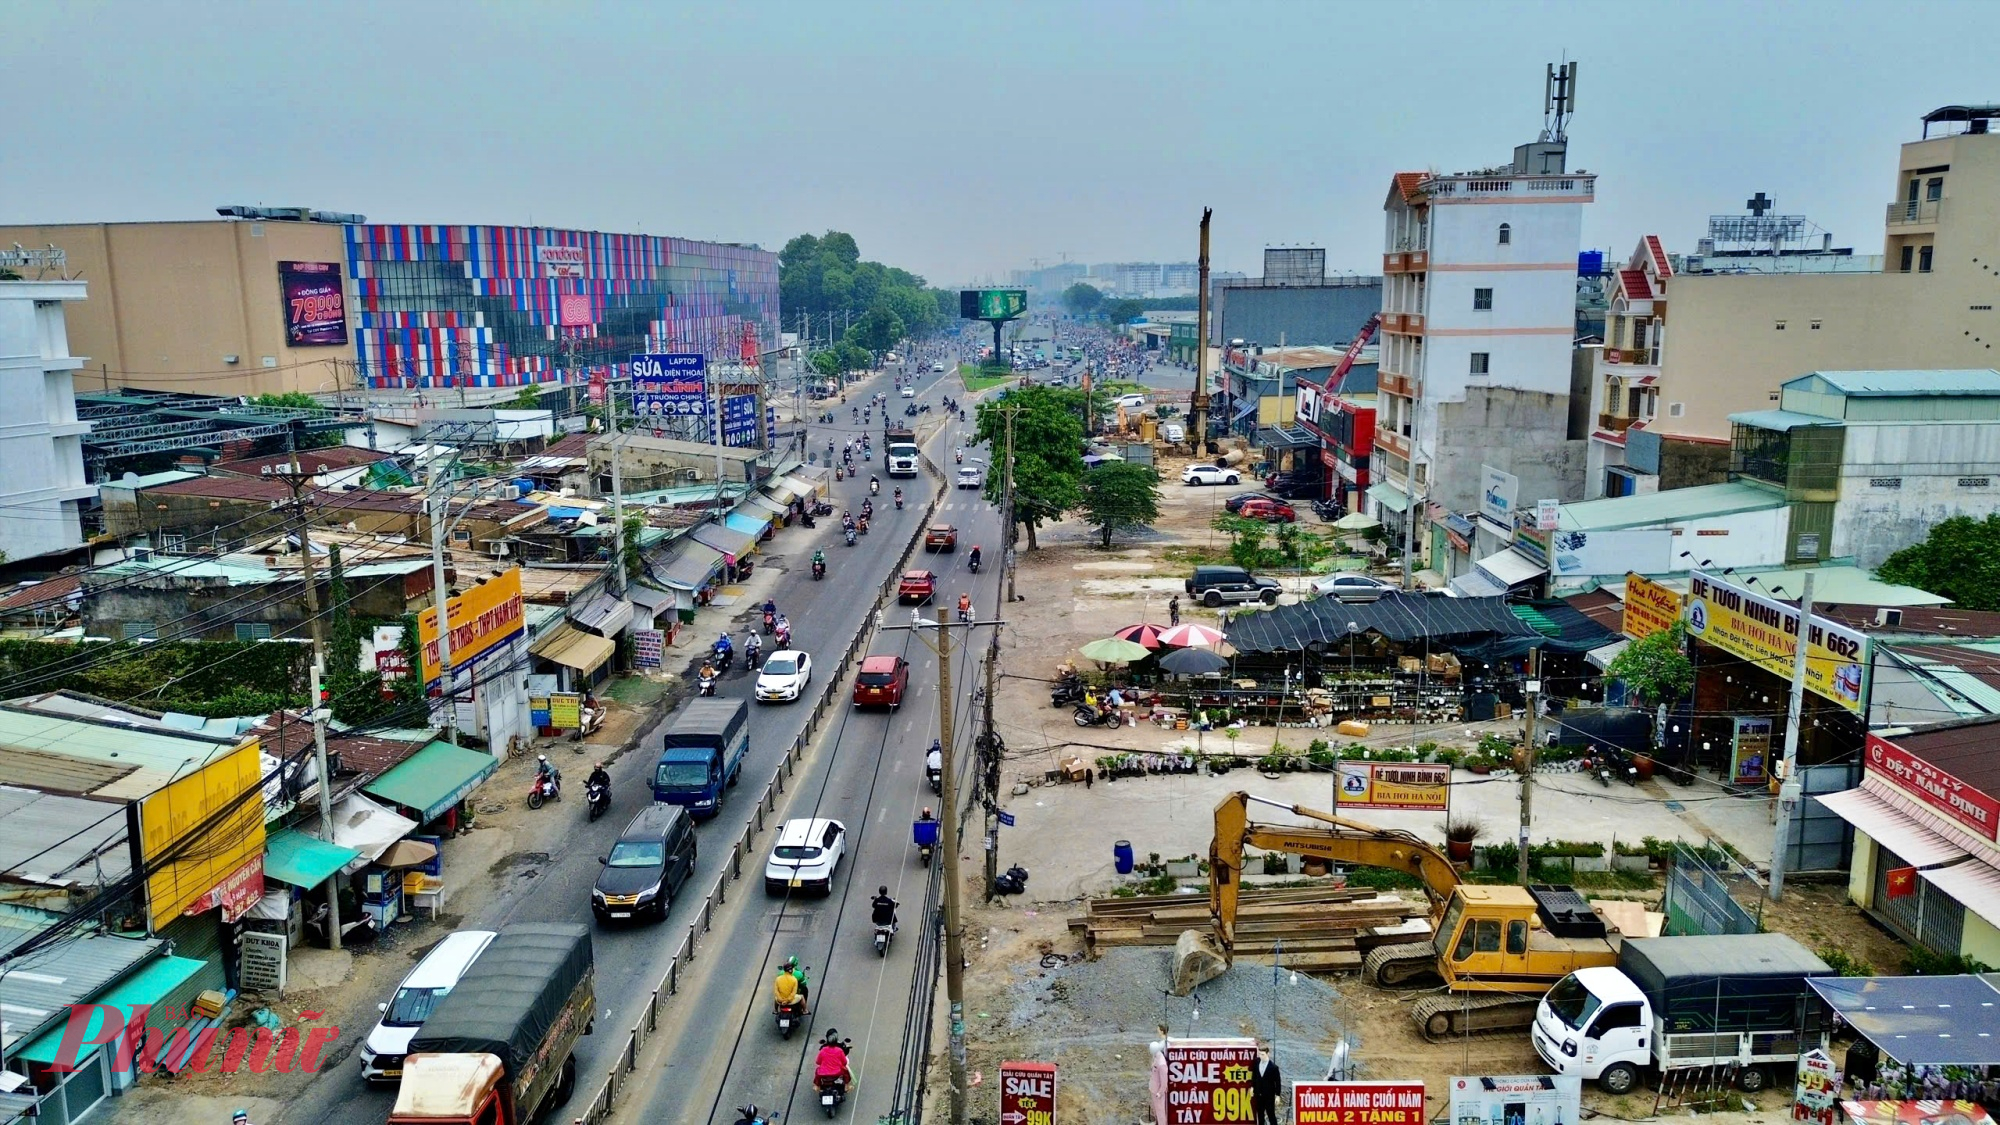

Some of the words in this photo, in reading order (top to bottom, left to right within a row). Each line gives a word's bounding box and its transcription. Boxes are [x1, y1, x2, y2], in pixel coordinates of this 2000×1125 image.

[632, 356, 663, 377] SỬA
[664, 368, 680, 378] ĐIỆN
[682, 370, 704, 378] THOẠI
[662, 378, 703, 393] KÍNH
[1692, 578, 1708, 600] DÊ
[1712, 586, 1740, 612] TƯƠI
[1744, 599, 1780, 629] NINH
[1826, 632, 1860, 661] 662
[1730, 617, 1746, 632] BIA
[1768, 632, 1782, 649] HÀ
[1756, 644, 1769, 656] Liên
[1376, 769, 1384, 780] DÊ
[1434, 772, 1446, 782] 662
[1911, 760, 1936, 779] ĐẠI
[1942, 776, 1962, 792] LÝ
[1377, 792, 1391, 800] BIA
[1412, 791, 1424, 800] HÀ
[1886, 757, 1912, 780] DỆT
[1916, 773, 1946, 800] NAM
[1950, 792, 1988, 822] ĐỊNH
[1284, 841, 1332, 852] MITSUBISHI
[1168, 1048, 1187, 1060] GIẢI
[1190, 1050, 1208, 1060] CỨU
[1210, 1048, 1236, 1062] QUẦN
[1238, 1049, 1255, 1060] TÂY
[1168, 1062, 1221, 1084] SALE
[1230, 1068, 1248, 1080] TẾT
[1006, 1077, 1052, 1098] SALE
[1169, 1086, 1208, 1106] QUẦN
[1212, 1088, 1254, 1122] 99K
[1299, 1087, 1325, 1108] TỔNG
[1328, 1088, 1341, 1108] XẢ
[1343, 1090, 1370, 1108] HÀNG
[1372, 1088, 1396, 1108] CUỐI
[1398, 1090, 1422, 1108] NĂM
[1026, 1110, 1052, 1125] 99K
[1176, 1107, 1202, 1124] TÂY
[1300, 1110, 1338, 1122] MUA
[1344, 1110, 1354, 1122] 2
[1360, 1108, 1406, 1124] TẶNG
[1412, 1111, 1419, 1122] 1
